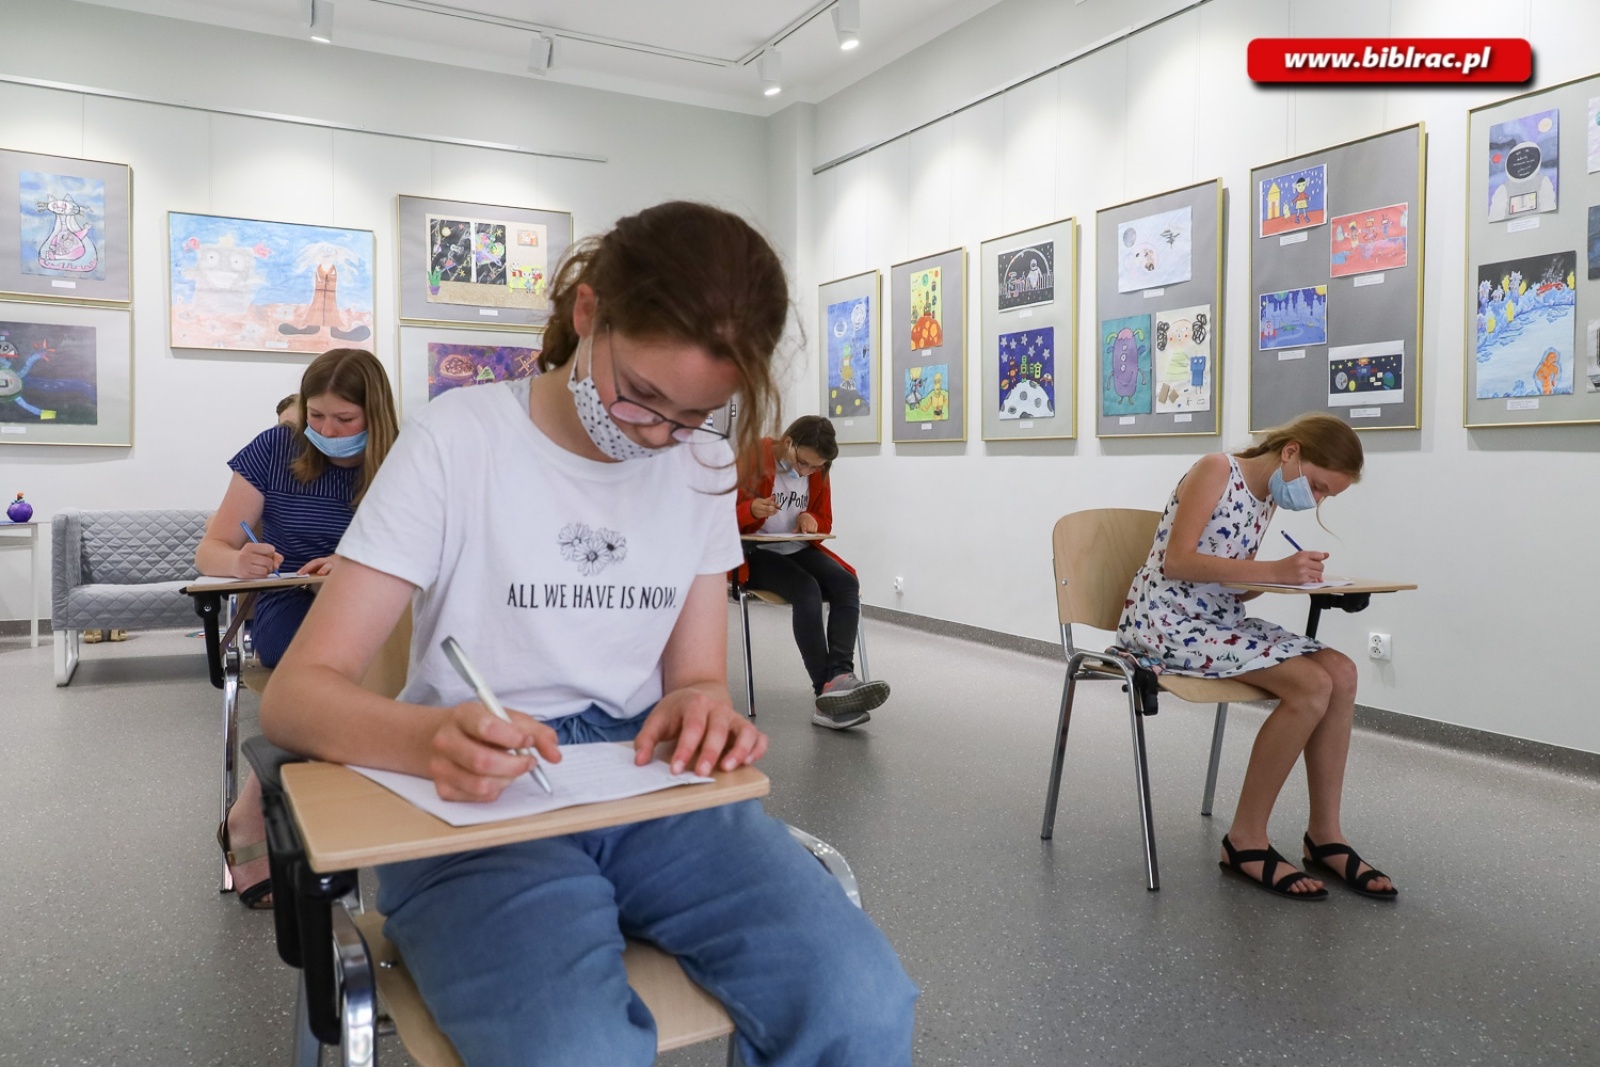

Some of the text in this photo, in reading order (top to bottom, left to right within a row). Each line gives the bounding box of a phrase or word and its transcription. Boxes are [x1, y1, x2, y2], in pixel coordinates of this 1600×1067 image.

[507, 582, 677, 609] ALL WE HAVE IS NOW.
